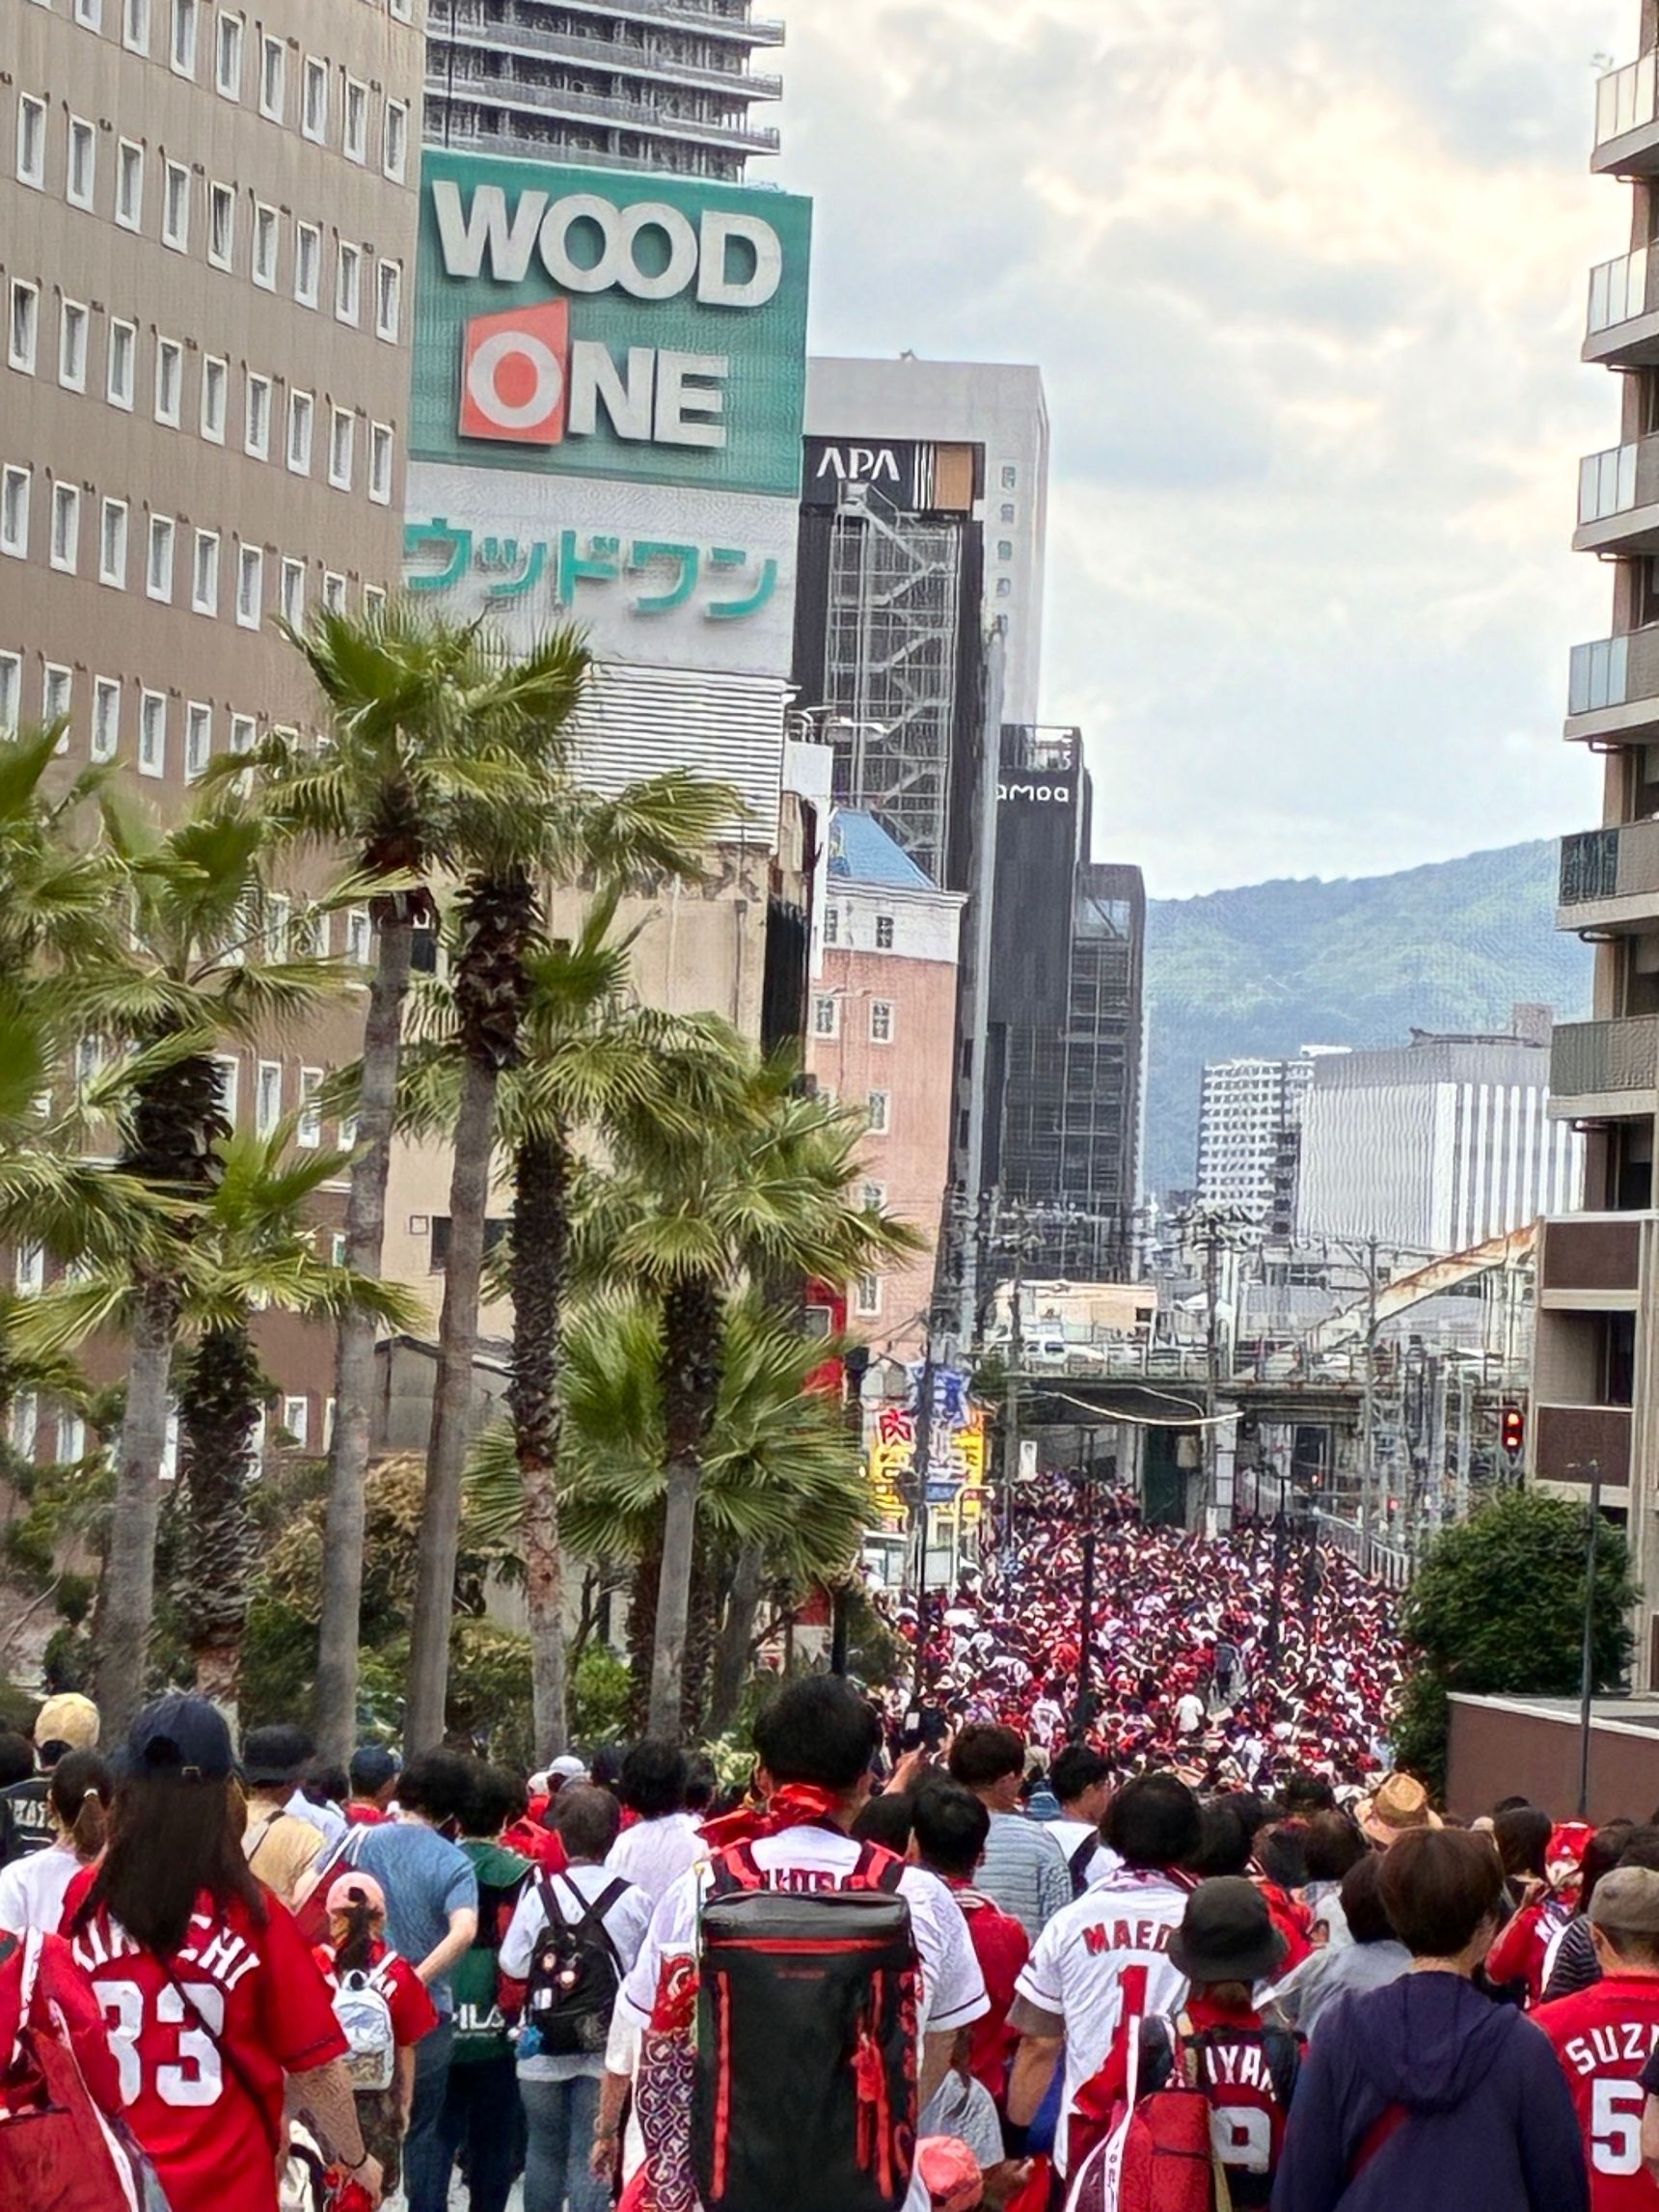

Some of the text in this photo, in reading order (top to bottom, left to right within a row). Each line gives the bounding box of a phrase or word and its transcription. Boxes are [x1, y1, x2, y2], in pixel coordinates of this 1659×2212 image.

[432, 180, 783, 308] WOOD
[467, 330, 729, 448] ONE
[817, 448, 901, 481] APA
[404, 517, 778, 620] ウッドワン
[92, 1980, 225, 2107] 33
